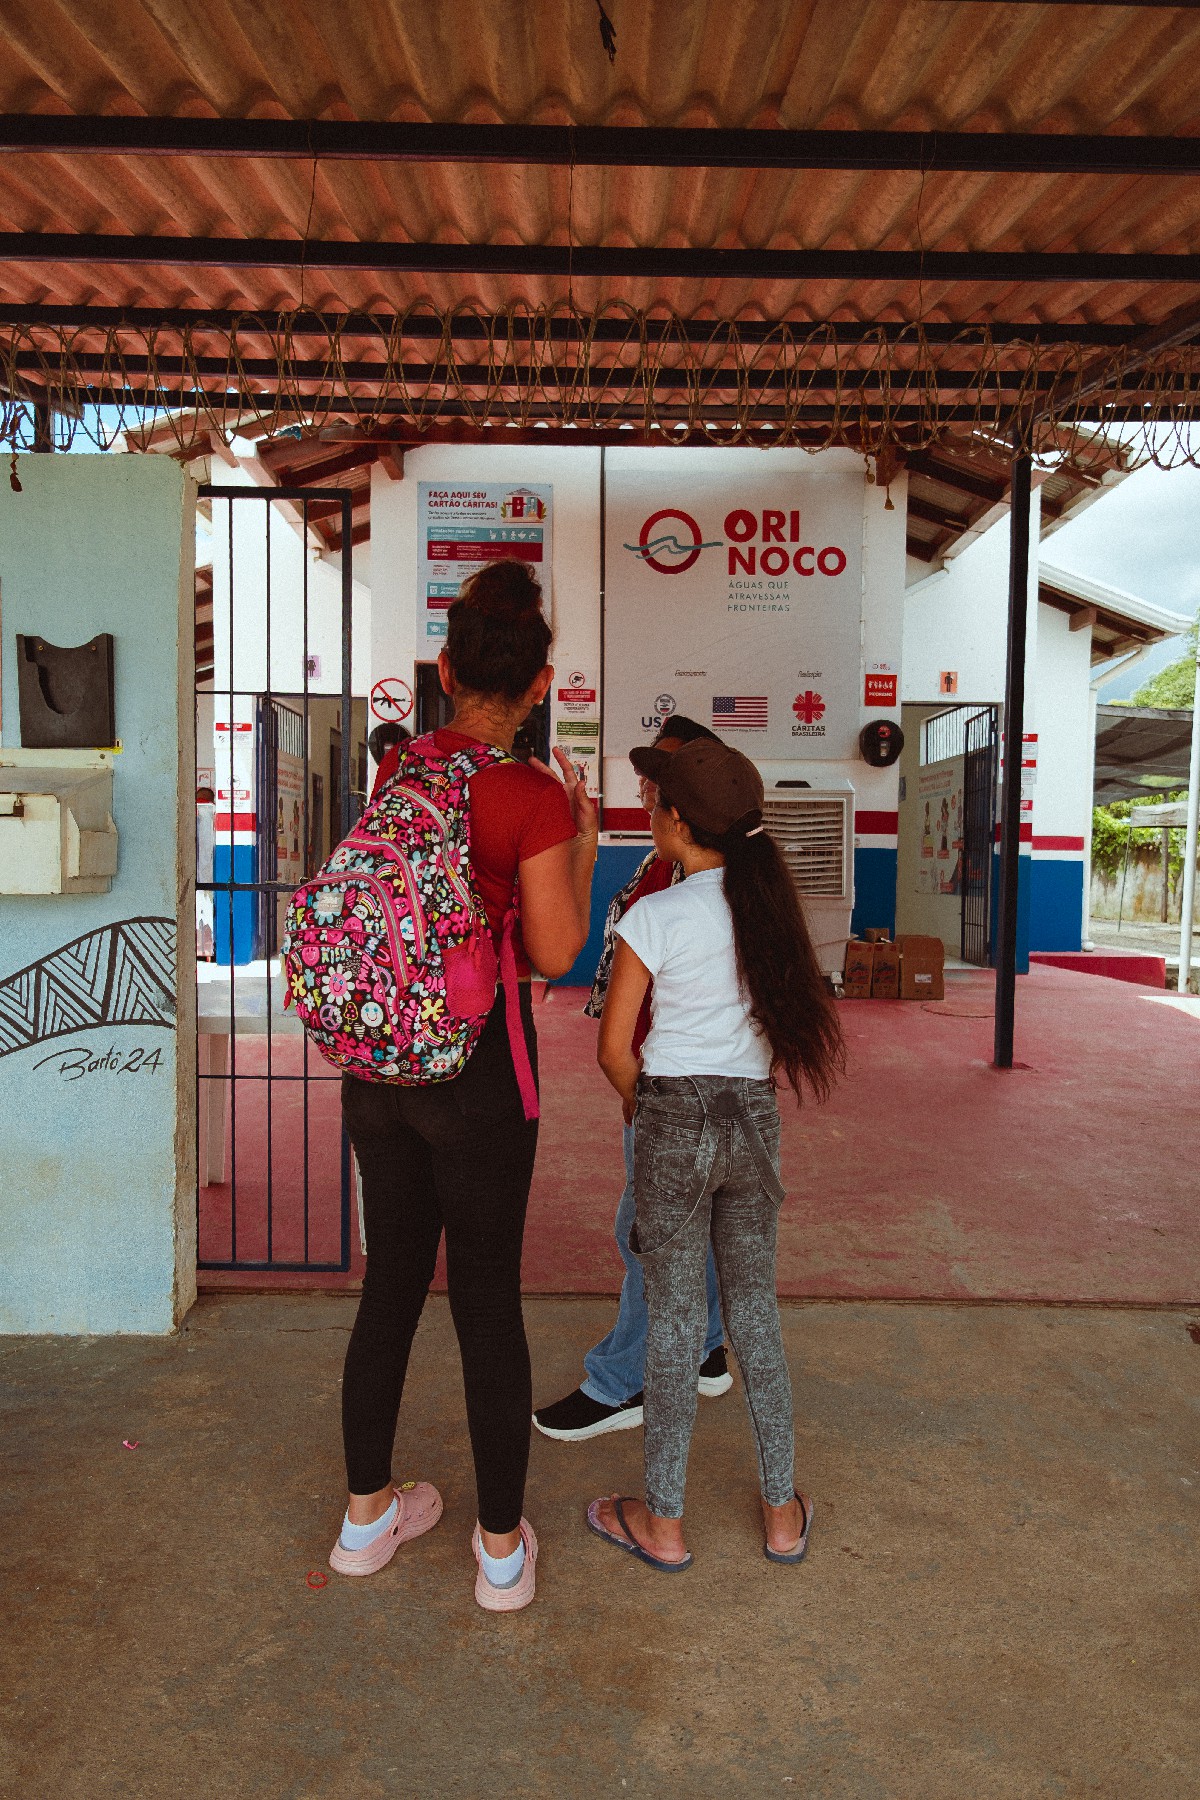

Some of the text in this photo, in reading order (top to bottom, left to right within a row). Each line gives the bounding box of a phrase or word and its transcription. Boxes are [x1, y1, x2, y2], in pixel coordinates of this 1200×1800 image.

[428, 491, 449, 500] FAÇA
[451, 491, 471, 499] AQUI
[428, 499, 498, 509] CARTÃO CÁRITAS!
[723, 509, 800, 543] ORI
[728, 546, 847, 577] NOCO
[728, 580, 789, 589] ÁGUAS QUE
[727, 604, 790, 612] FRONTEIRAS
[791, 724, 826, 732] CÁRITAS
[116, 1047, 164, 1076] 24
